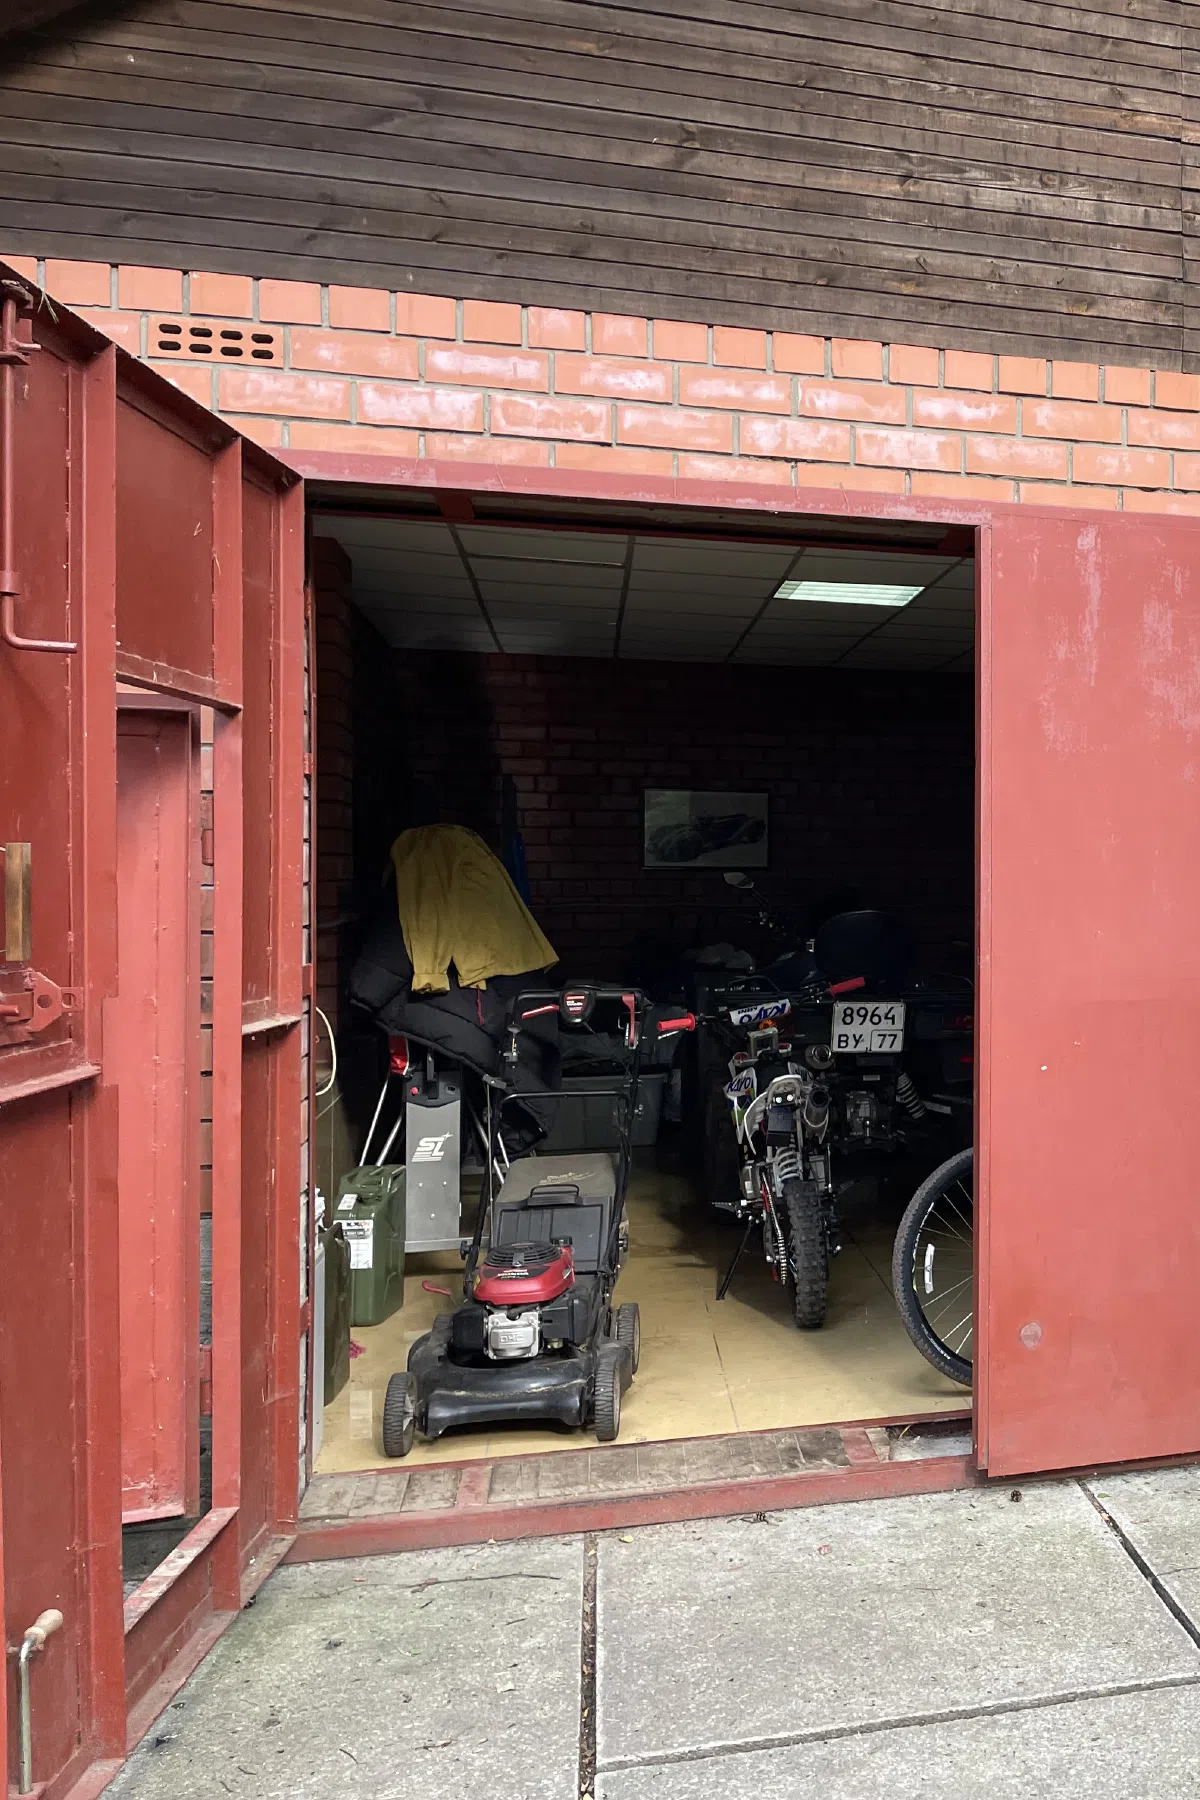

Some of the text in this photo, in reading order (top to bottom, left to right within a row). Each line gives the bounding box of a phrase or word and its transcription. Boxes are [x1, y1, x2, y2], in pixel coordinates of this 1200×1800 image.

[739, 1003, 787, 1025] KAYO
[842, 1006, 896, 1026] 8964
[877, 1033, 898, 1049] 77
